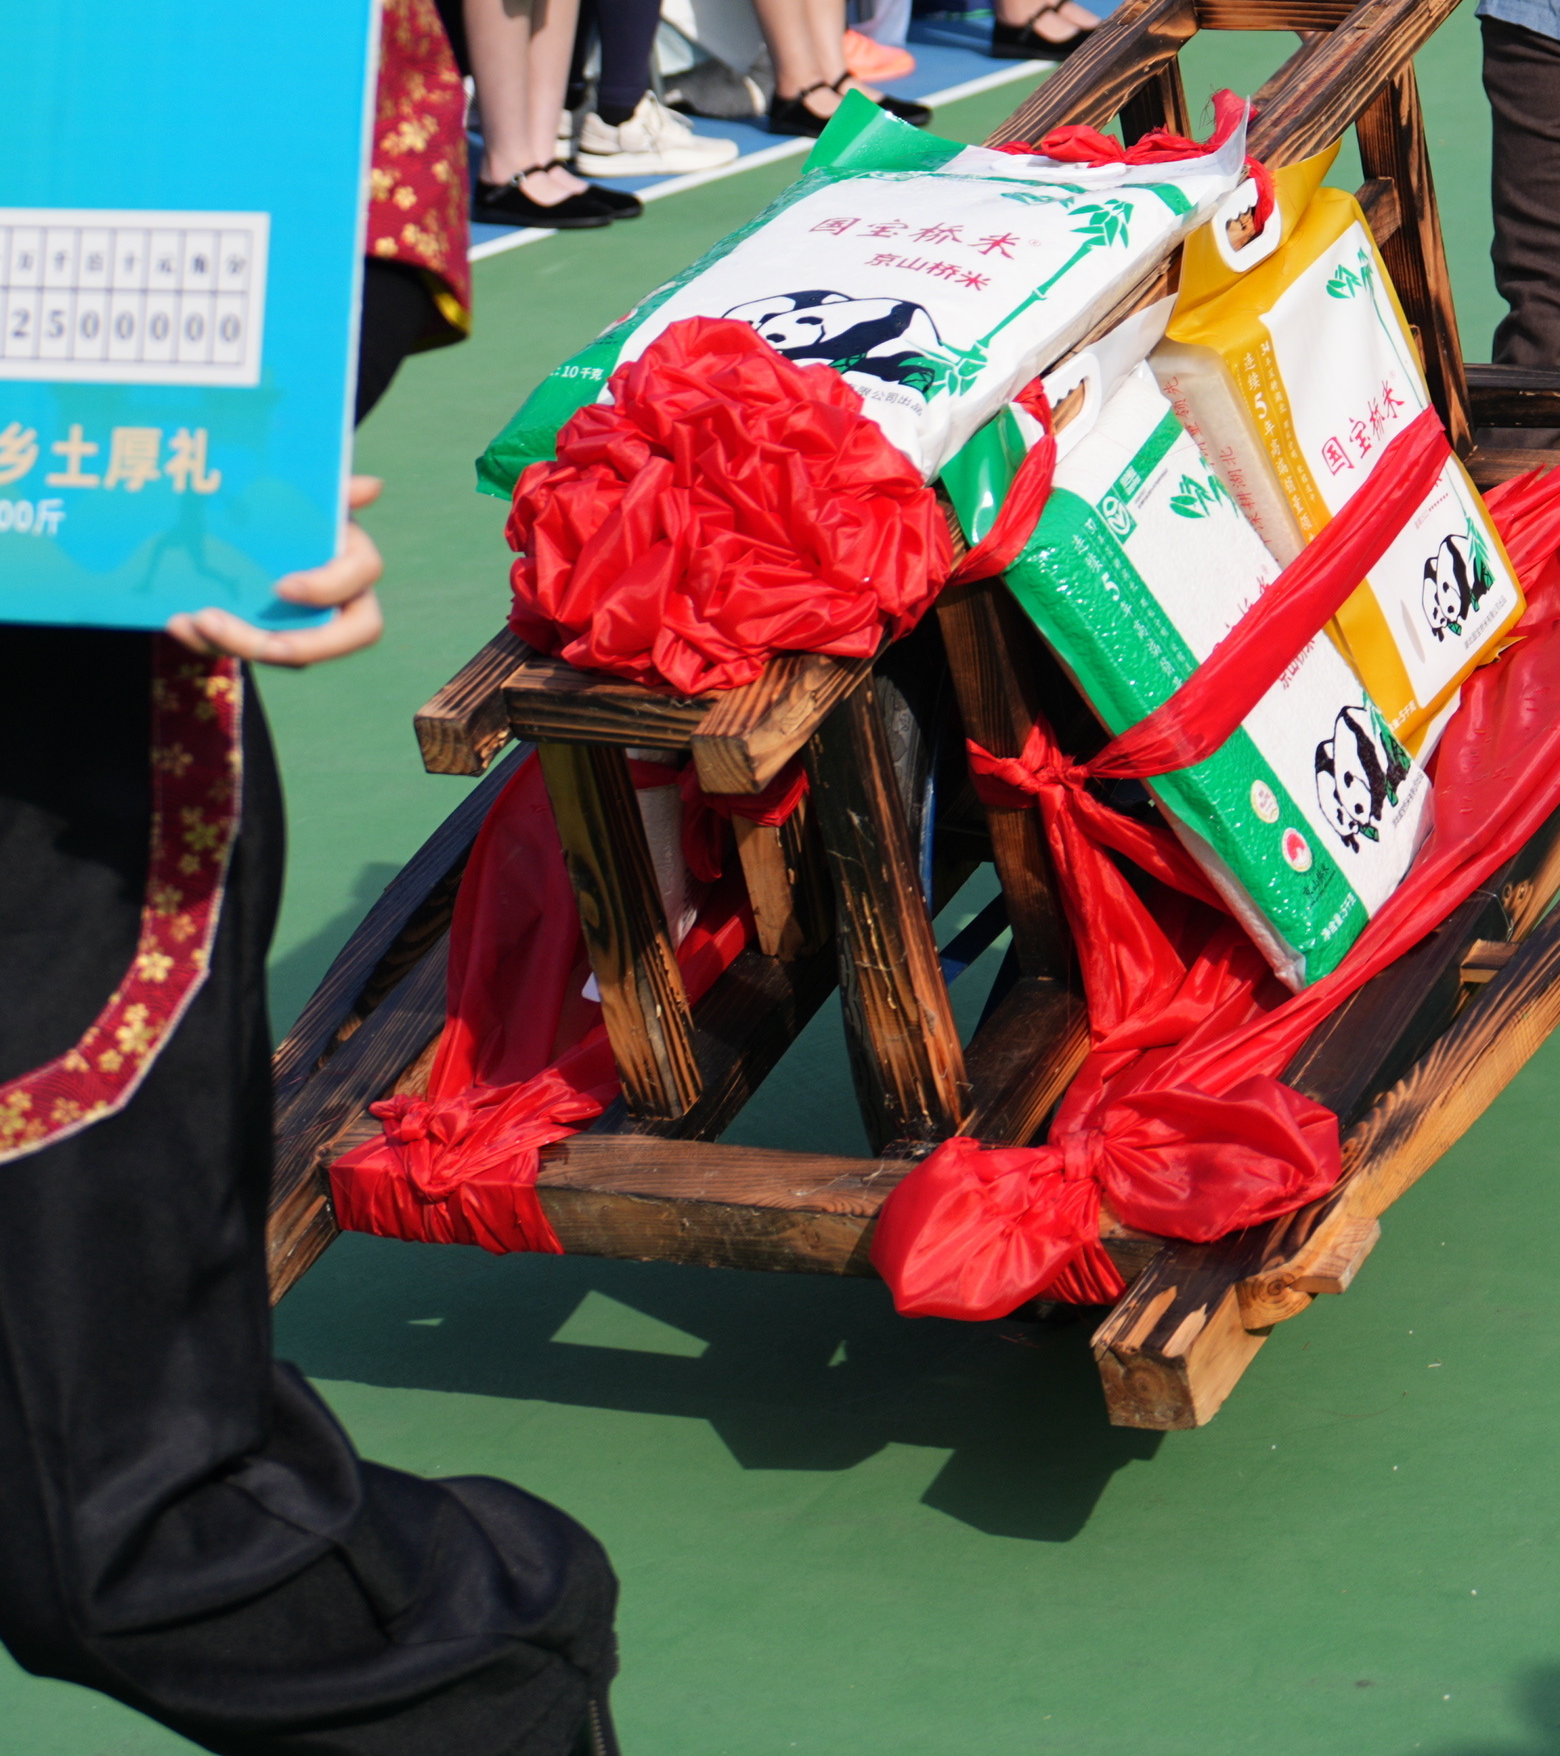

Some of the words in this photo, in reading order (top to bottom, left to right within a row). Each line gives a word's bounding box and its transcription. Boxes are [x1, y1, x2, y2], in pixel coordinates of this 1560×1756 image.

[809, 217, 1020, 260] 国宝桥米
[864, 253, 991, 291] 京山桥米
[1321, 380, 1406, 476] 国宝桥米
